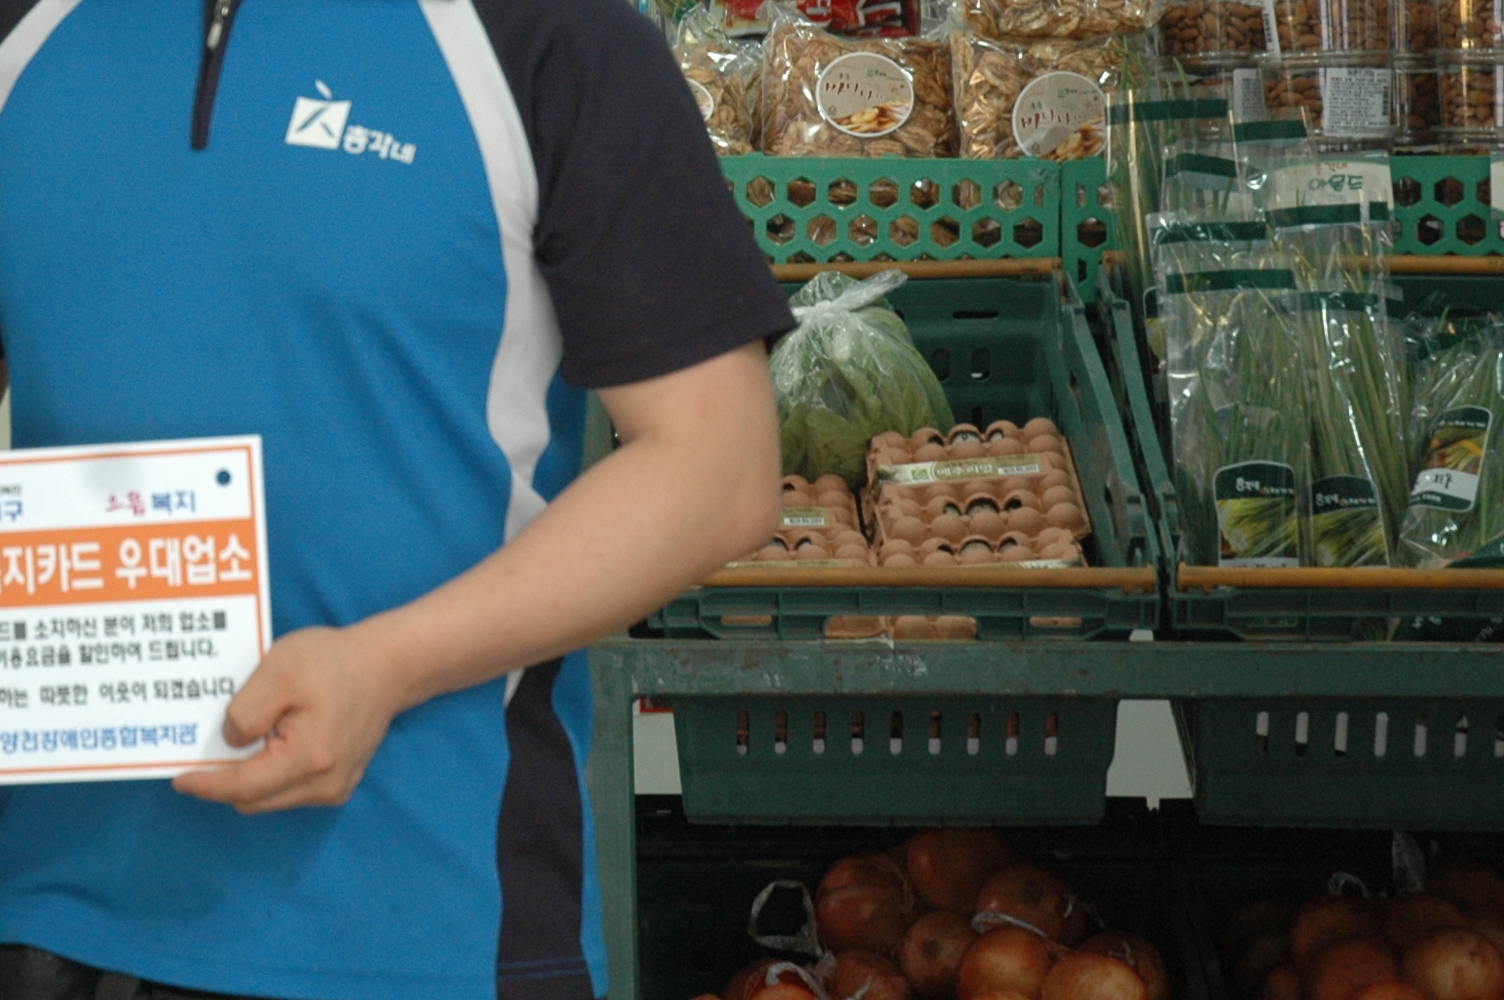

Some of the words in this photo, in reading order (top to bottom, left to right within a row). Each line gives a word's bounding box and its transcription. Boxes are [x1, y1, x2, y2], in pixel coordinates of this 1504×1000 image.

[115, 533, 252, 589] 우대업소
[35, 615, 97, 640] 소지하신
[103, 613, 135, 637] 분이
[142, 610, 173, 633] 저희
[180, 610, 227, 632] 업소를
[79, 640, 142, 665] 할인하여
[40, 683, 88, 707] 따뜻한
[99, 680, 147, 703] 이웃이
[0, 723, 199, 755] 양천장애인종합복지관
